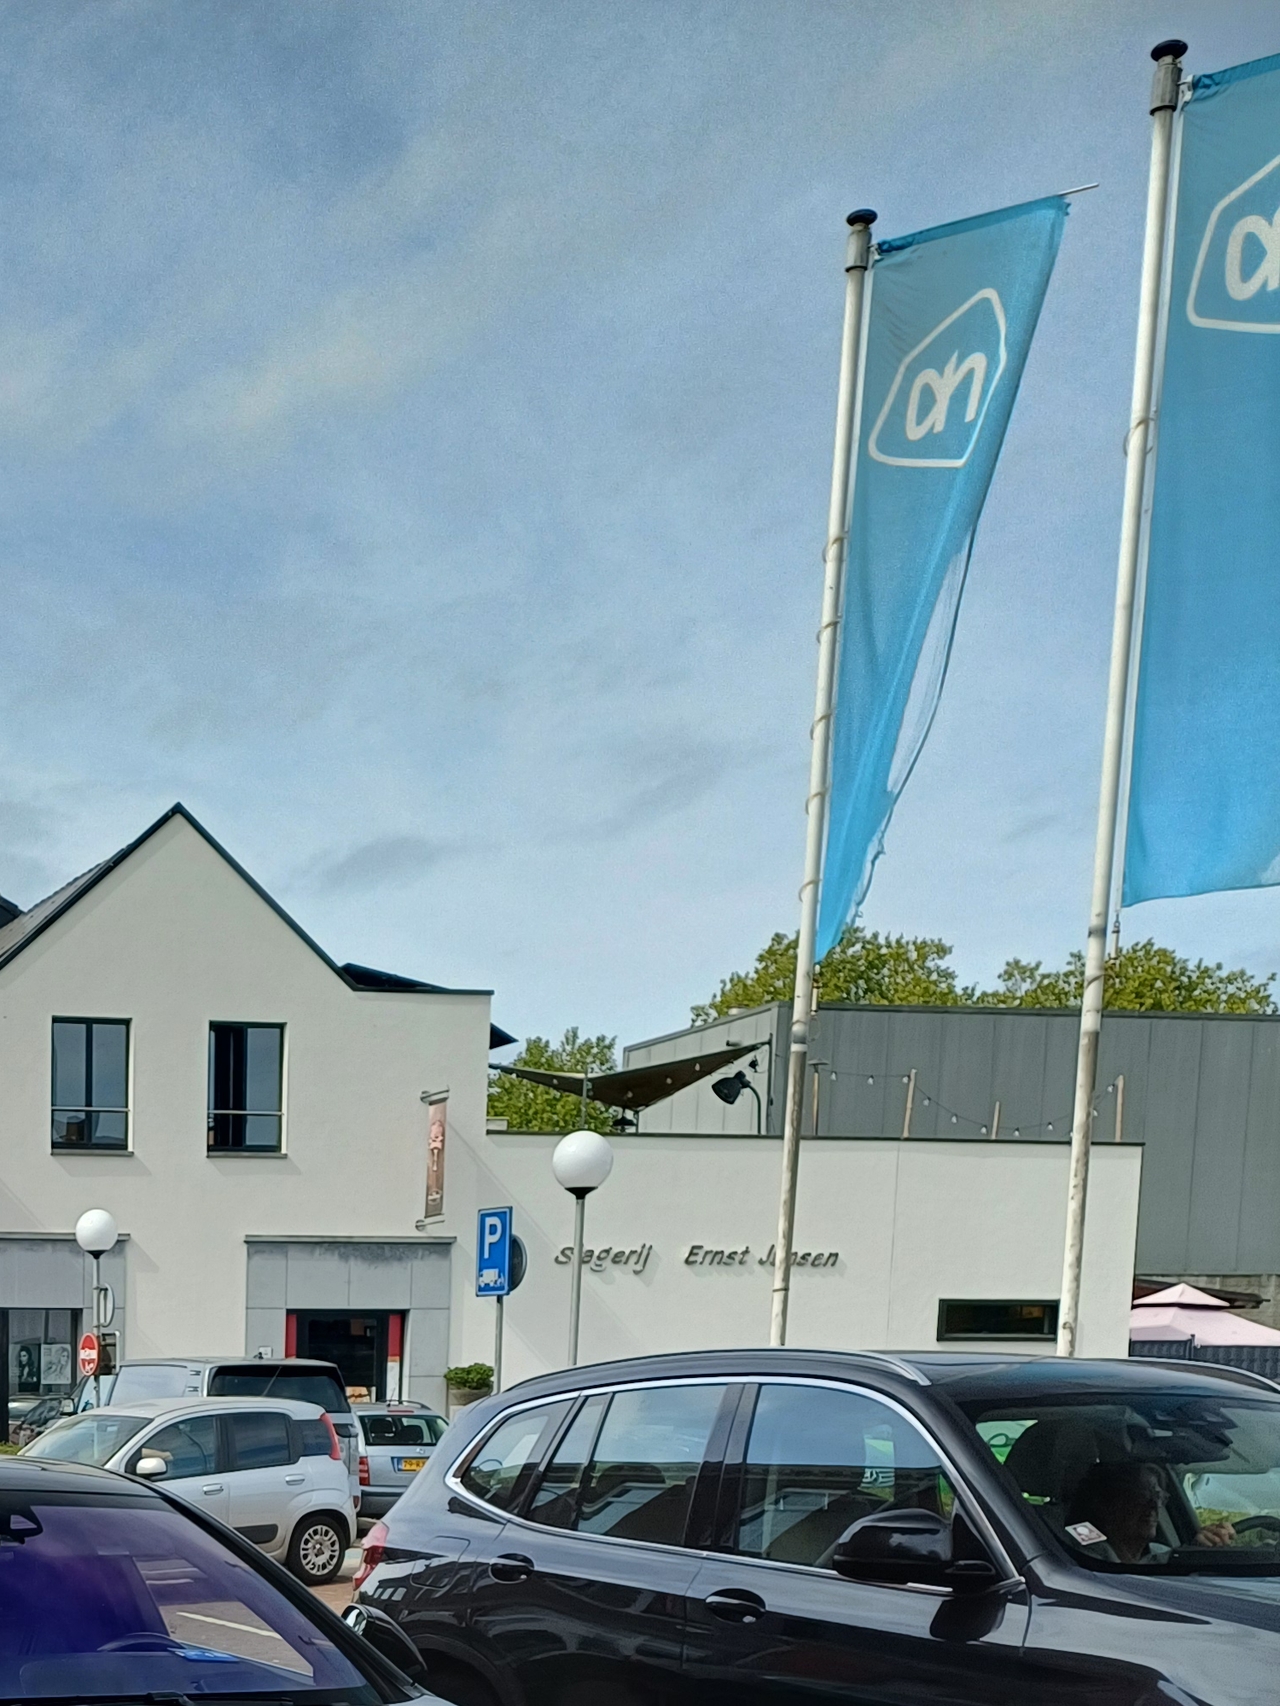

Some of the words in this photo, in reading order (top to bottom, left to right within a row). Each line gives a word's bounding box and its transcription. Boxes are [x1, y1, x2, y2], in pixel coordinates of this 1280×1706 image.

[483, 1215, 503, 1260] P
[553, 1242, 654, 1276] Sagerij
[683, 1244, 752, 1267] Ernst
[757, 1243, 840, 1268] Jnsen
